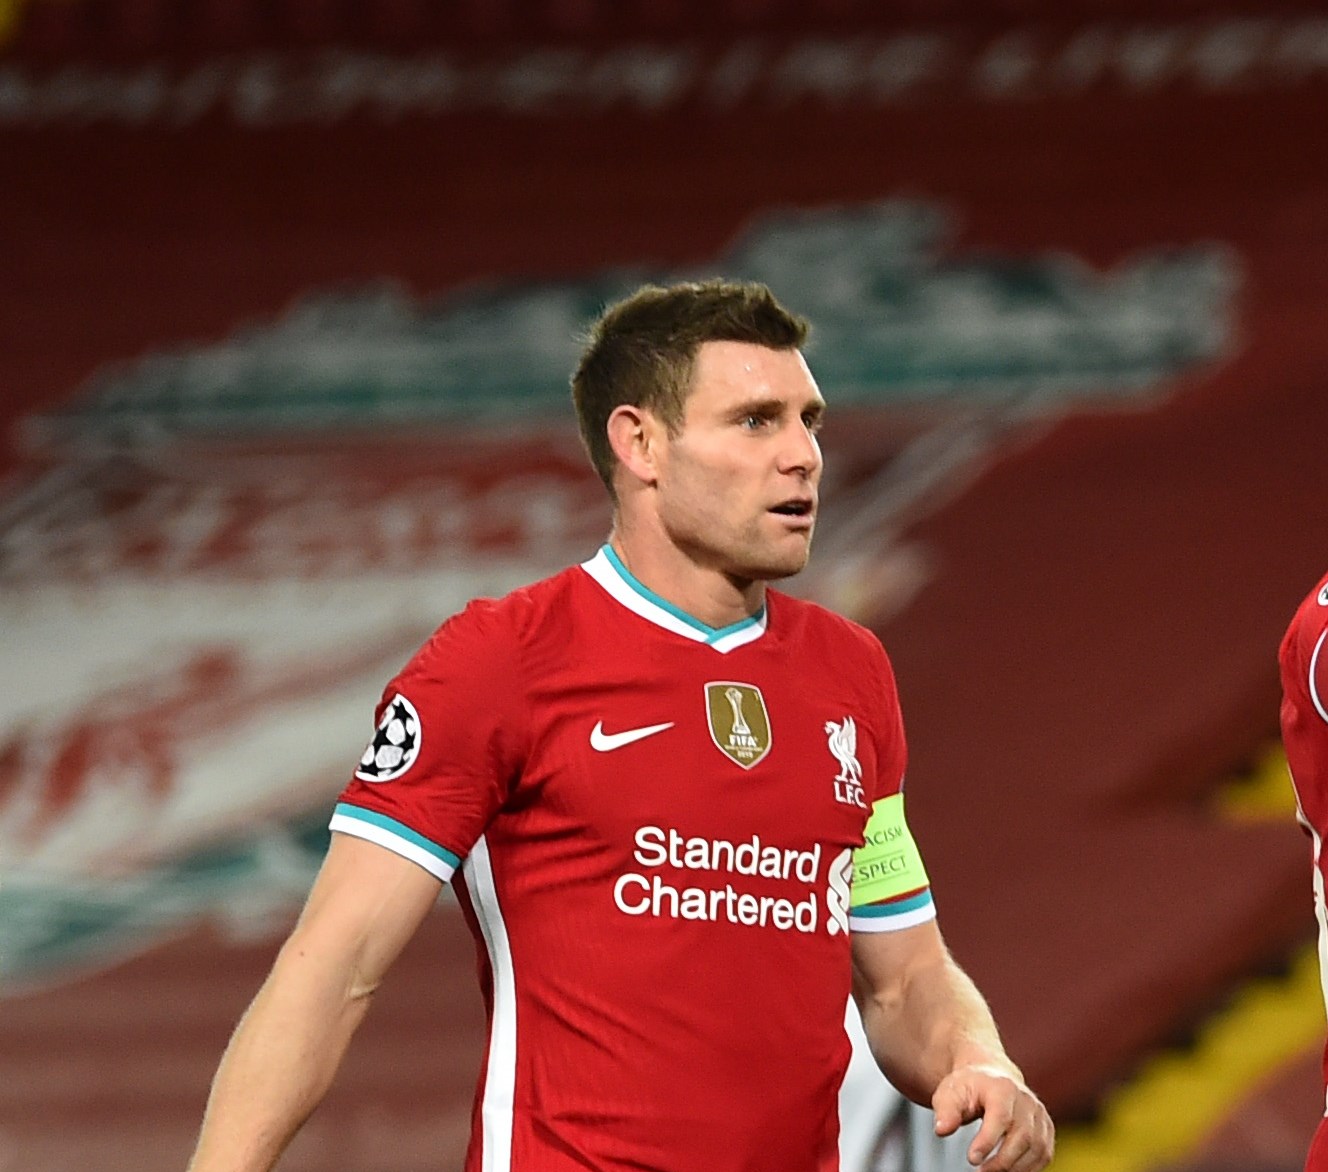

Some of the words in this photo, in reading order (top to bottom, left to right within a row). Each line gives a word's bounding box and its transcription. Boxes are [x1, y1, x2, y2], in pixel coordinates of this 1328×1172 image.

[729, 734, 757, 747] FIFA
[634, 826, 821, 882] Standard
[850, 854, 908, 883] ESPECT
[613, 873, 817, 933] Chartered
